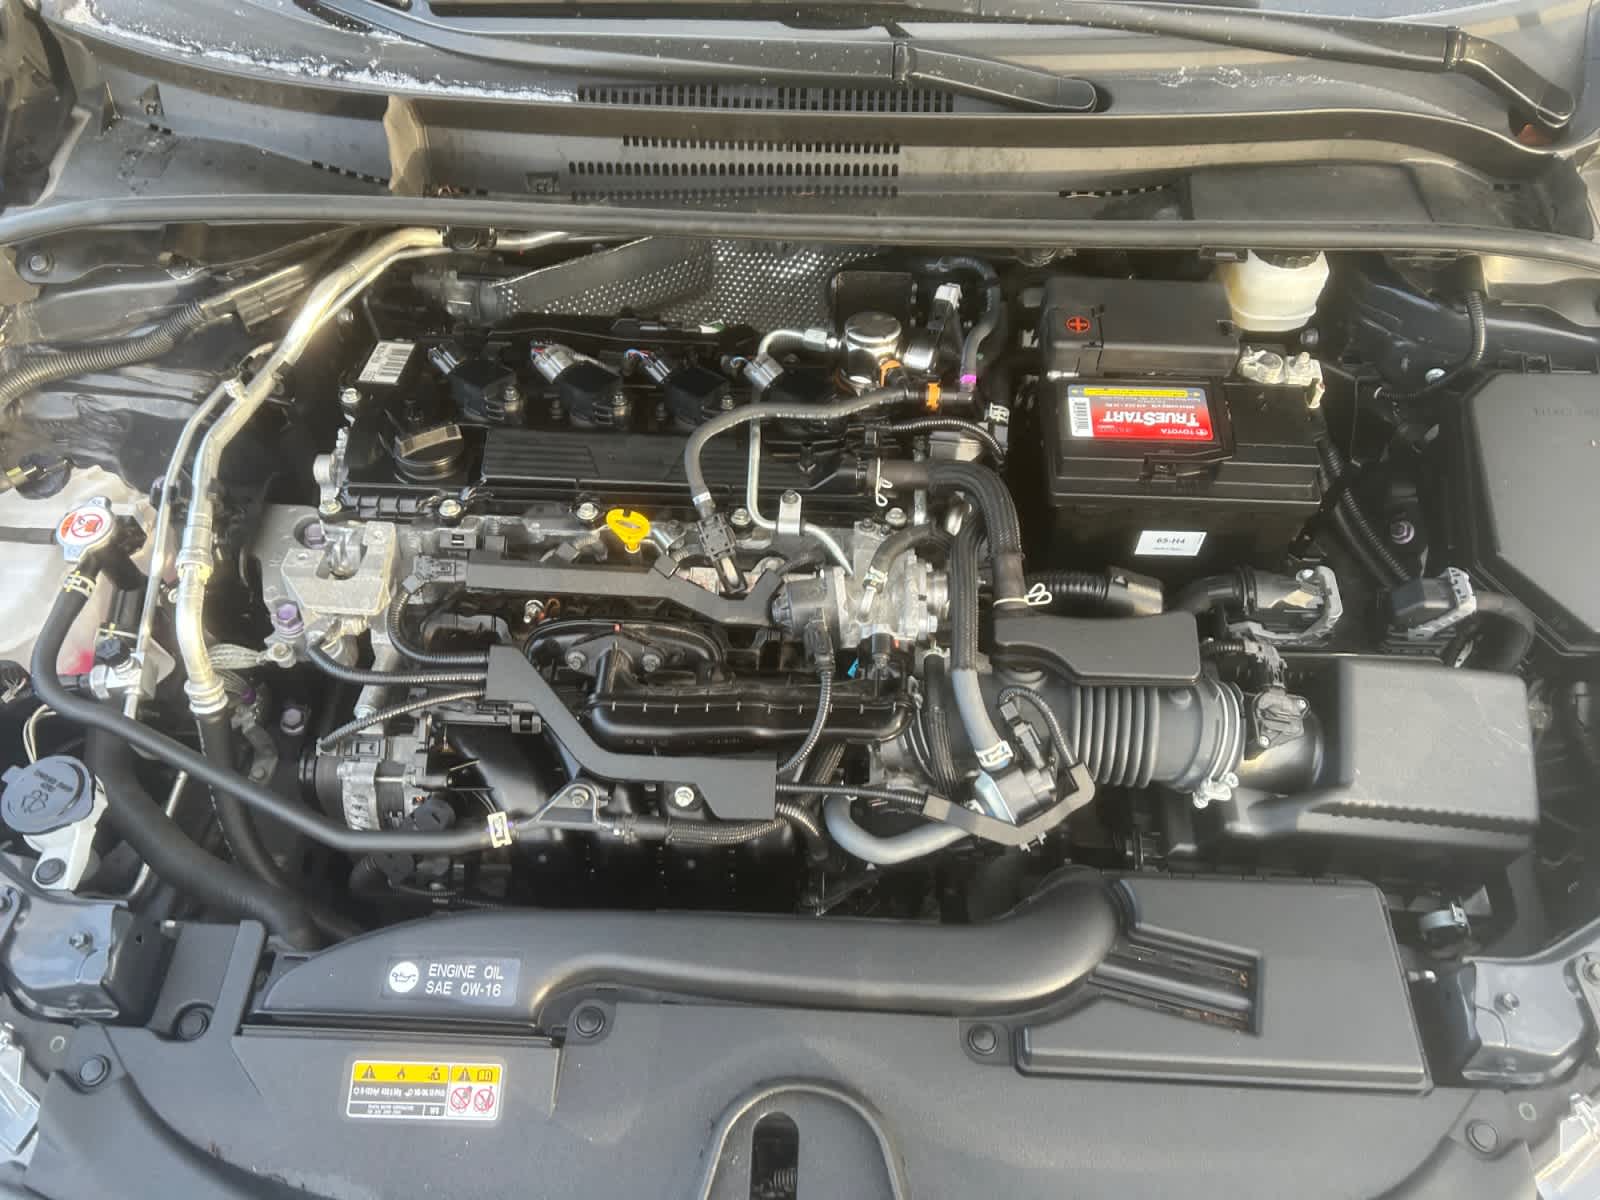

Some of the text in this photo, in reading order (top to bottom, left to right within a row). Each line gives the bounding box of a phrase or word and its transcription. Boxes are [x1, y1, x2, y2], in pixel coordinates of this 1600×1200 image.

[428, 963, 504, 981] ENGINE OIL
[425, 980, 502, 998] SAE 0W-16
